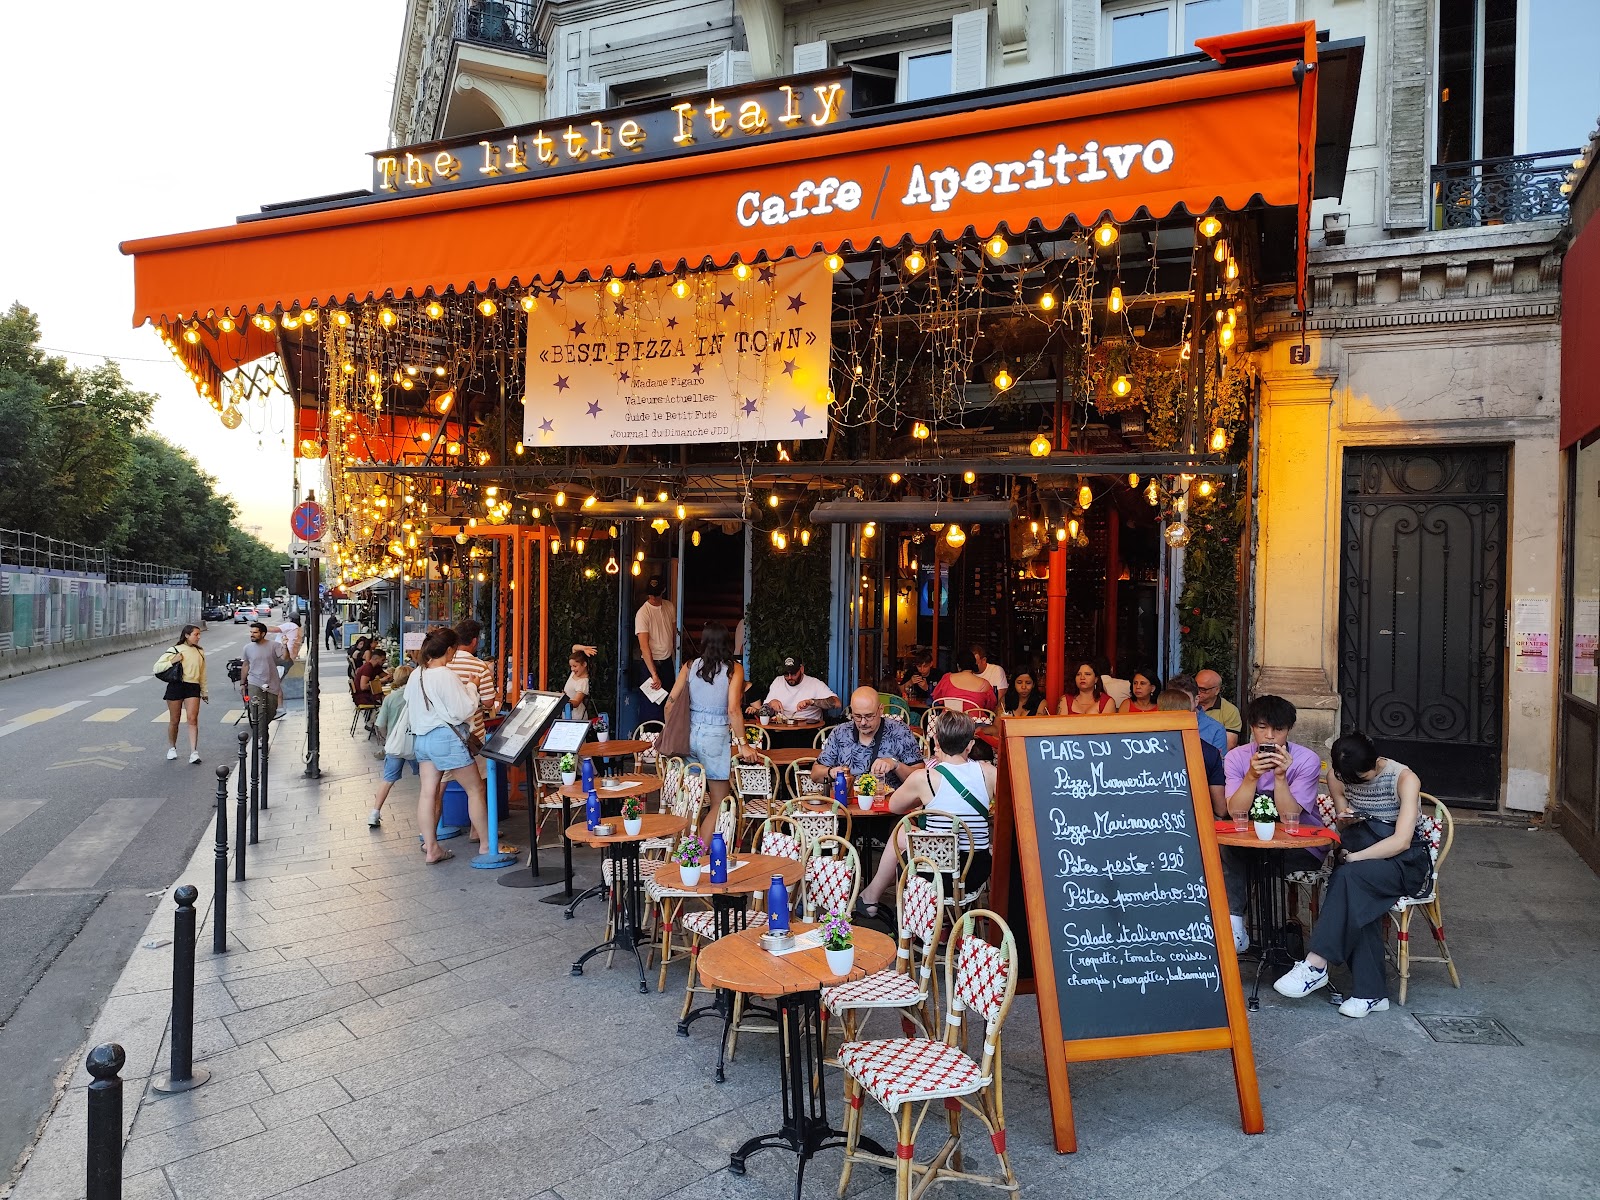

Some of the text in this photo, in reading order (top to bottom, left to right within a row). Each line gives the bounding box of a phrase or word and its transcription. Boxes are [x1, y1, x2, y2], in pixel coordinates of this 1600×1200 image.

[377, 82, 843, 190] The little Italy
[736, 177, 863, 228] Caffe
[901, 138, 1175, 213] Aperitivo
[614, 336, 686, 362] PIZZA
[695, 332, 726, 357] IN
[633, 376, 705, 389] Madame Figaro
[624, 393, 715, 406] Valeurs Actuelles
[624, 409, 718, 422] Guide le Petit Futé
[610, 426, 729, 439] Journal du Dimanche JDD
[1039, 739, 1085, 761] PLATS
[1088, 740, 1112, 758] DU
[1053, 766, 1091, 799] Pizza
[1049, 807, 1091, 846] Pizza
[1063, 922, 1115, 947] Salade
[1123, 949, 1166, 963] tomates
